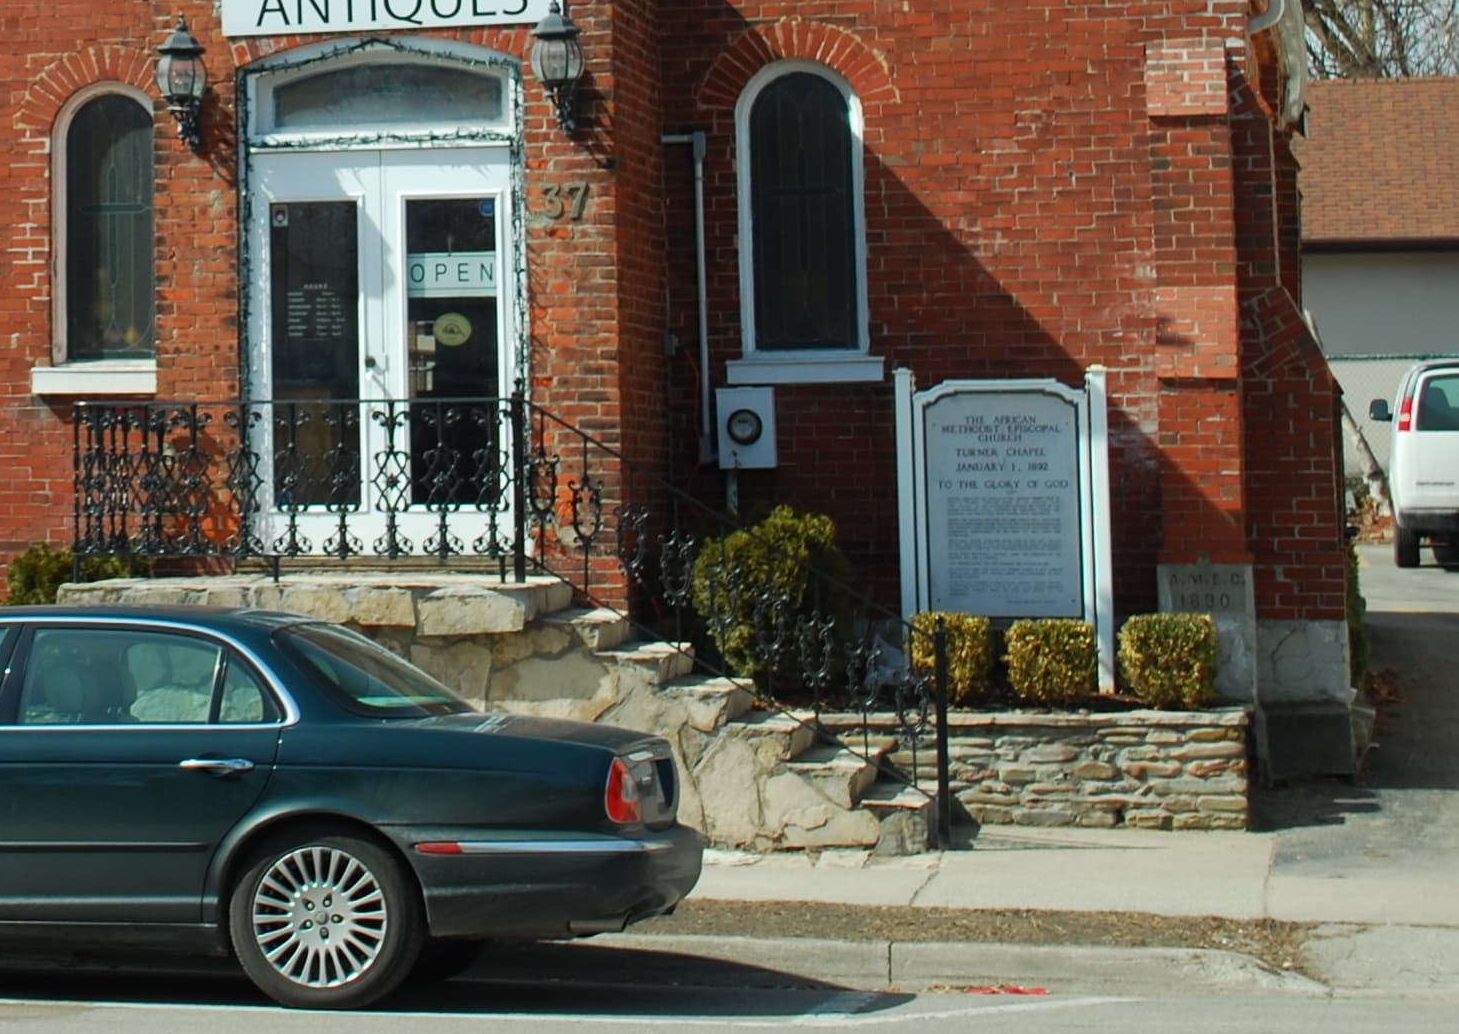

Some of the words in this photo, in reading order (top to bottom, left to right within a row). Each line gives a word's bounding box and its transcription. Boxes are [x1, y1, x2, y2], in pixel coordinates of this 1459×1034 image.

[542, 182, 589, 221] 37
[410, 262, 493, 283] OPEN
[964, 415, 984, 424] THE
[993, 415, 1037, 424] AFRICAN
[941, 425, 999, 434] METHODIST
[1007, 425, 1061, 433] EPISCOPAL
[977, 433, 1022, 443] CHURCH
[956, 448, 998, 457] TURNER
[1005, 447, 1045, 456] CHAPEL
[956, 462, 1005, 472] JANUARY
[1028, 462, 1049, 471] 1892
[939, 481, 953, 490] TO
[959, 480, 978, 489] THE
[984, 480, 1020, 489] GLORY
[1027, 480, 1038, 489] OF
[1044, 480, 1069, 489] GOD
